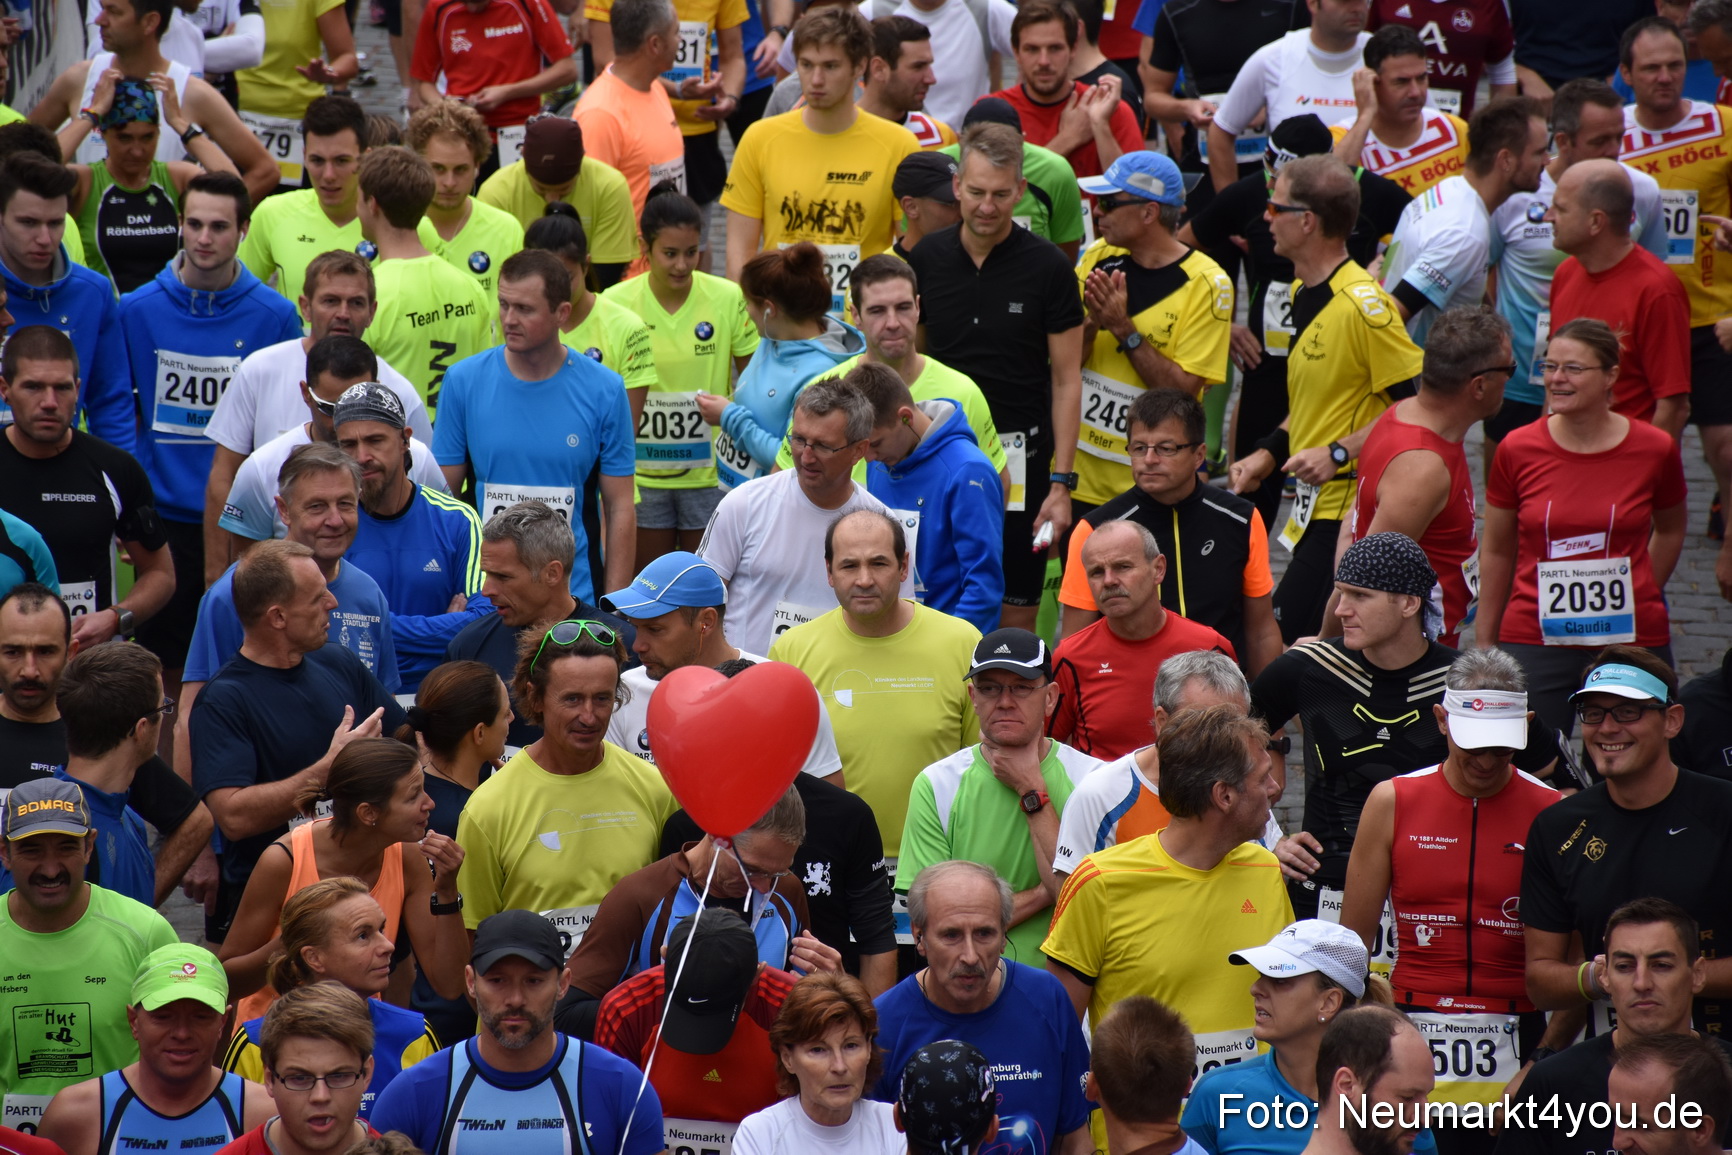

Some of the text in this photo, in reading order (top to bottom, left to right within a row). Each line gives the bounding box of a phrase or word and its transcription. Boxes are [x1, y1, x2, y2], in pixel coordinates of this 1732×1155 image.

[484, 23, 524, 38] Marcel
[674, 39, 699, 64] 31
[1425, 59, 1467, 78] EVA
[1313, 98, 1358, 108] KLEB
[264, 131, 293, 159] 79
[1667, 147, 1728, 170] BÖGL
[1420, 156, 1466, 183] BÖGL
[826, 171, 858, 182] swn
[126, 214, 152, 226] DAV
[106, 223, 177, 238] Röthenbach
[694, 342, 716, 353] Partl
[159, 356, 231, 376] PARTL Neumarkt
[1081, 376, 1138, 403] PARTL Neumark
[656, 399, 697, 410] Neumarkt
[1083, 393, 1131, 435] 248
[637, 410, 704, 441] 2032
[1088, 429, 1115, 451] Peter
[645, 445, 693, 460] Vanessa
[50, 493, 97, 503] PFLEIDERER
[486, 492, 516, 503] PARTL
[1565, 540, 1592, 552] DEHN
[1540, 567, 1617, 580] PARTL Neumarkt
[1549, 579, 1627, 614] 2039
[332, 611, 381, 624] 12. NEUMARKTER
[774, 610, 792, 621] RTL
[342, 619, 371, 630] STADTLAUF
[1565, 619, 1611, 634] Claudia
[17, 799, 76, 817] BOMAG
[1557, 819, 1588, 856] HORST
[1418, 842, 1447, 851] Triathlon
[1321, 899, 1343, 912] PAR
[549, 917, 580, 926] ARTL
[1398, 911, 1457, 923] MEDERER
[1268, 963, 1297, 973] sailfish
[4, 972, 32, 983] um den
[84, 975, 107, 986] Sepp
[0, 985, 29, 996] lfsberg
[30, 1012, 44, 1020] alter
[45, 1008, 77, 1028] Hut
[1444, 1023, 1499, 1035] Neumarkt
[1195, 1040, 1242, 1056] Neumarkt
[1429, 1037, 1498, 1079] 503
[990, 1063, 1021, 1074] mburg
[994, 1068, 1042, 1082] bmarathon
[6, 1104, 44, 1116] PARTL
[668, 1128, 726, 1145] Neumarkt
